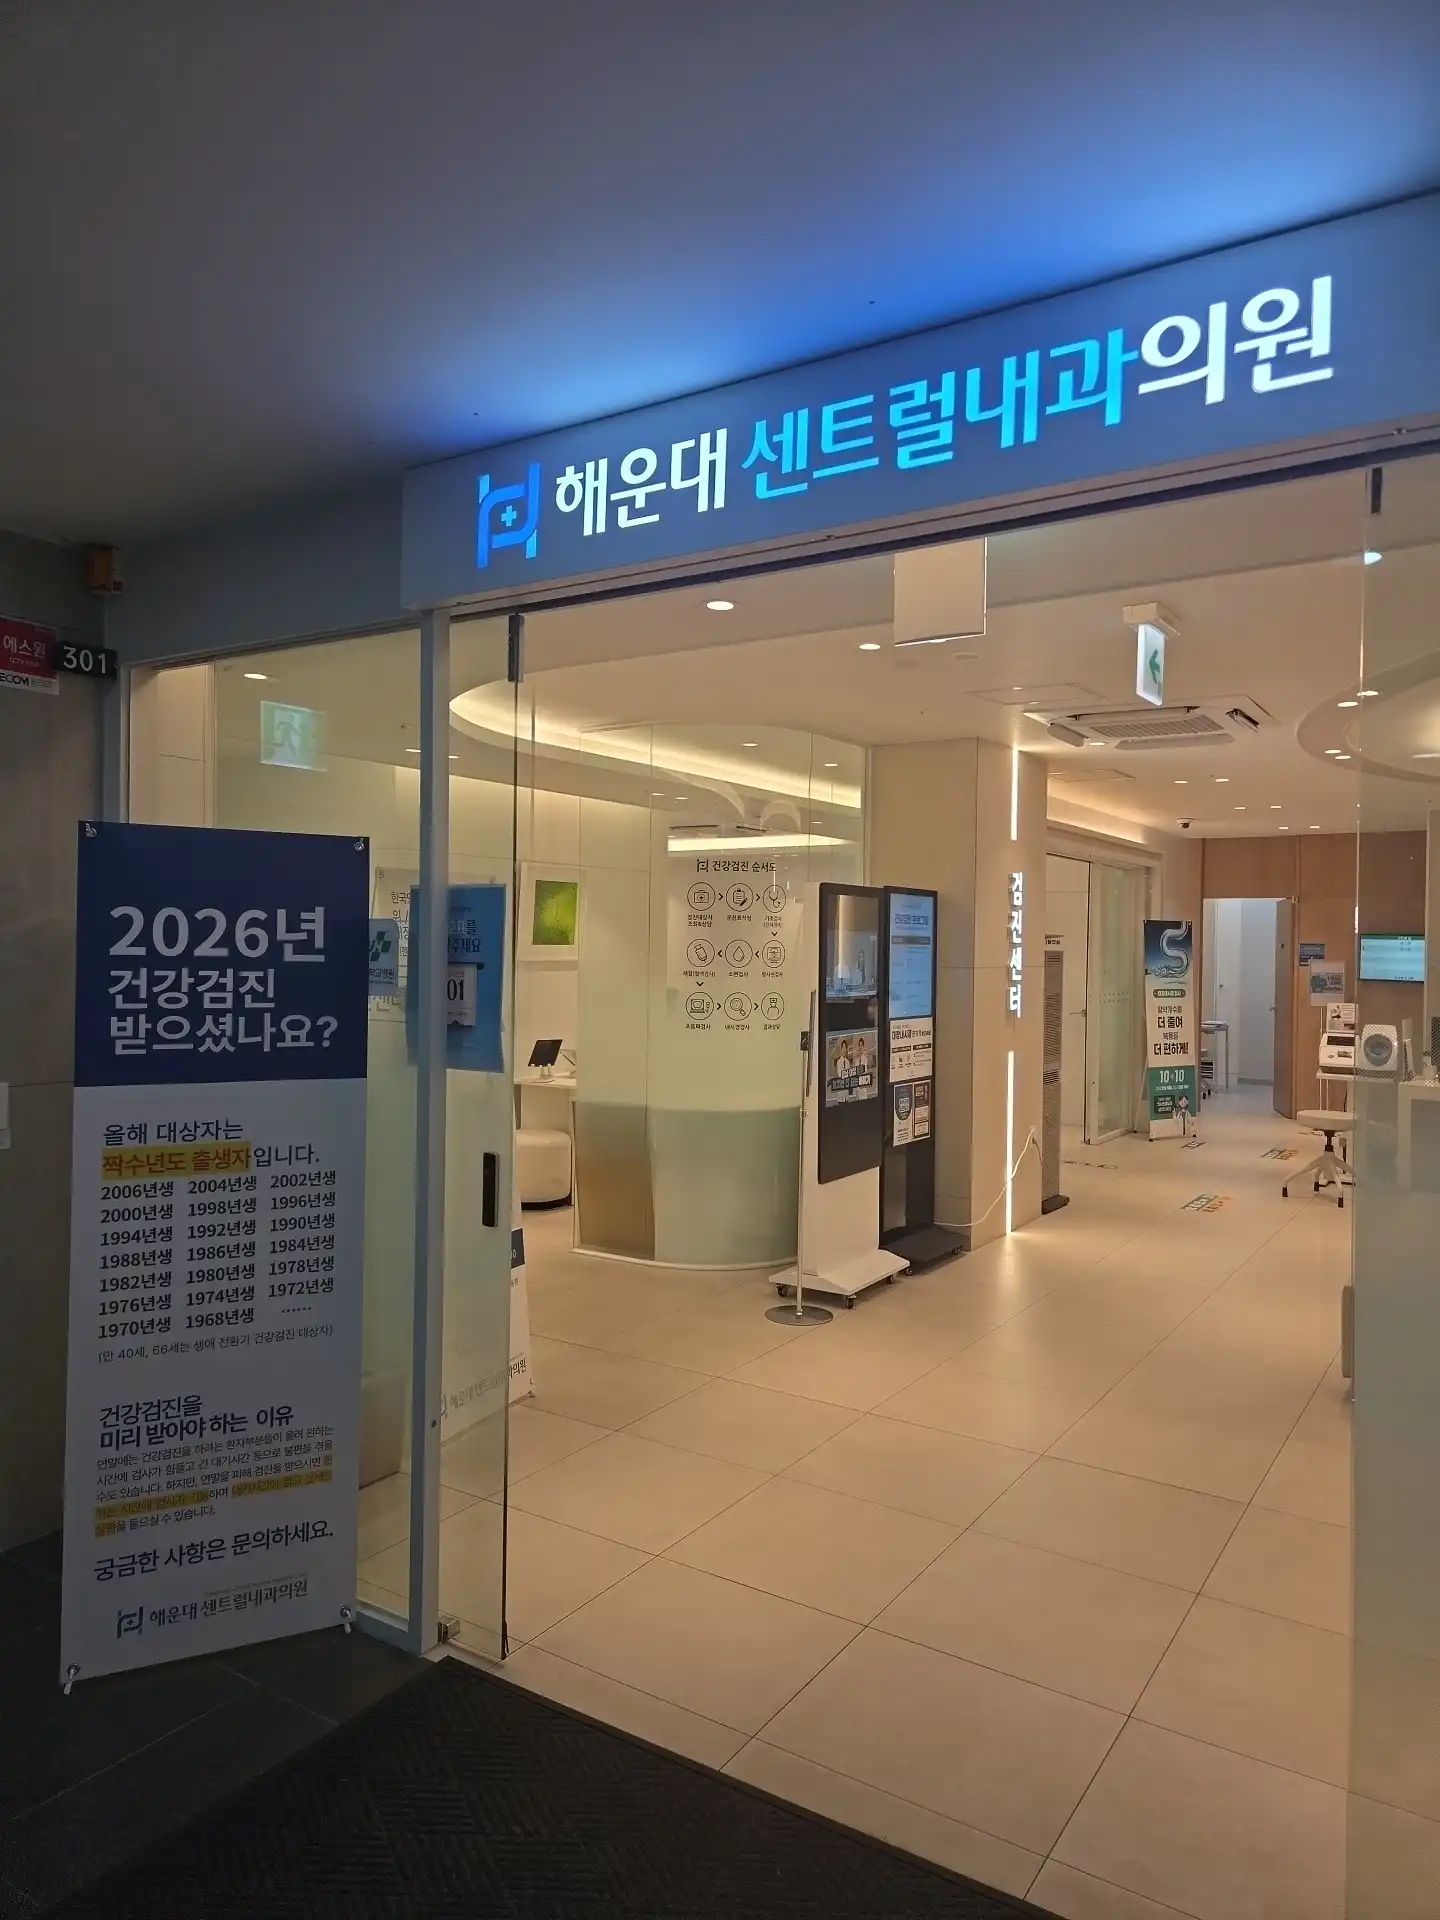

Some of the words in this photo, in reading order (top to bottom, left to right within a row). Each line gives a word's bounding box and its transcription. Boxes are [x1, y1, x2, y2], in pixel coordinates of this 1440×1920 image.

[555, 427, 728, 536] 해운대
[741, 275, 1335, 502] 센트럴내과의원
[3, 635, 45, 659] 에스원
[63, 645, 106, 674] 301
[712, 861, 749, 872] 건강검진
[752, 861, 777, 872] 순서도
[108, 905, 326, 963] 2026년
[1009, 872, 1023, 1018] 검진센터
[108, 967, 276, 1010] 건강검진
[110, 1012, 338, 1056] 받으셨나요?
[1158, 1016, 1165, 1028] 더
[1167, 1015, 1183, 1028] 줄여
[1154, 1043, 1161, 1055] 더
[1163, 1042, 1189, 1055] 편하게!
[103, 1122, 148, 1147] 올해
[156, 1117, 244, 1144] 대상자는
[102, 1151, 187, 1177] 짝수년도
[191, 1143, 321, 1172] 출생자입니다.
[101, 1181, 174, 1200] 2006년생
[188, 1175, 257, 1195] 2004년생
[270, 1170, 336, 1189] 2002년생
[100, 1204, 174, 1224] 2000년생
[188, 1197, 257, 1217] 1998년생
[270, 1191, 336, 1211] 1996년생
[100, 1226, 173, 1247] 1994년생
[187, 1219, 257, 1239] 1992년생
[270, 1213, 336, 1233] 1990년생
[99, 1248, 172, 1270] 1988년생
[186, 1241, 256, 1262] 1986년생
[269, 1234, 335, 1254] 1984년생
[99, 1271, 172, 1293] 1982년생
[186, 1263, 255, 1284] 1980년생
[269, 1255, 335, 1276] 1978년생
[98, 1294, 172, 1316] 1976년생
[186, 1285, 255, 1307] 1974년생
[268, 1277, 334, 1298] 1972년생
[98, 1316, 171, 1339] 1970년생
[185, 1308, 254, 1329] 1968년생
[98, 1350, 114, 1364] (만
[118, 1346, 149, 1361] 40세,
[152, 1342, 190, 1356] 66세는
[193, 1339, 215, 1352] 생애
[219, 1335, 250, 1348] 전환기
[253, 1329, 295, 1345] 건강검진
[298, 1324, 333, 1339] 대상자)
[100, 1395, 203, 1429] 건강검진을
[100, 1425, 141, 1452] 미리
[146, 1418, 207, 1446] 받아야
[209, 1412, 249, 1435] 하는
[257, 1405, 294, 1428] 이유
[96, 1471, 128, 1487] 시간에
[131, 1465, 162, 1481] 검사가
[165, 1460, 195, 1476] 힘들고
[211, 1452, 250, 1469] 대기시간
[284, 1442, 312, 1457] 불편을
[97, 1454, 138, 1470] 연말에는
[141, 1445, 191, 1463] 건강검진을
[193, 1440, 224, 1456] 하려는
[305, 1425, 334, 1438] 원하는
[95, 1489, 118, 1503] 수도
[120, 1482, 164, 1499] 있습니다.
[166, 1476, 198, 1490] 하지만,
[200, 1470, 230, 1485] 연말을
[232, 1465, 252, 1480] 피해
[254, 1461, 282, 1477] 검진을
[284, 1456, 321, 1472] 받으시면
[161, 1512, 172, 1524] 수
[173, 1504, 216, 1522] 있습니다.
[94, 1549, 160, 1582] 궁금한
[164, 1538, 227, 1567] 사항은
[231, 1520, 334, 1556] 문의하세요.
[150, 1602, 197, 1627] 해운대
[200, 1579, 308, 1618] 센트럴내과의원
